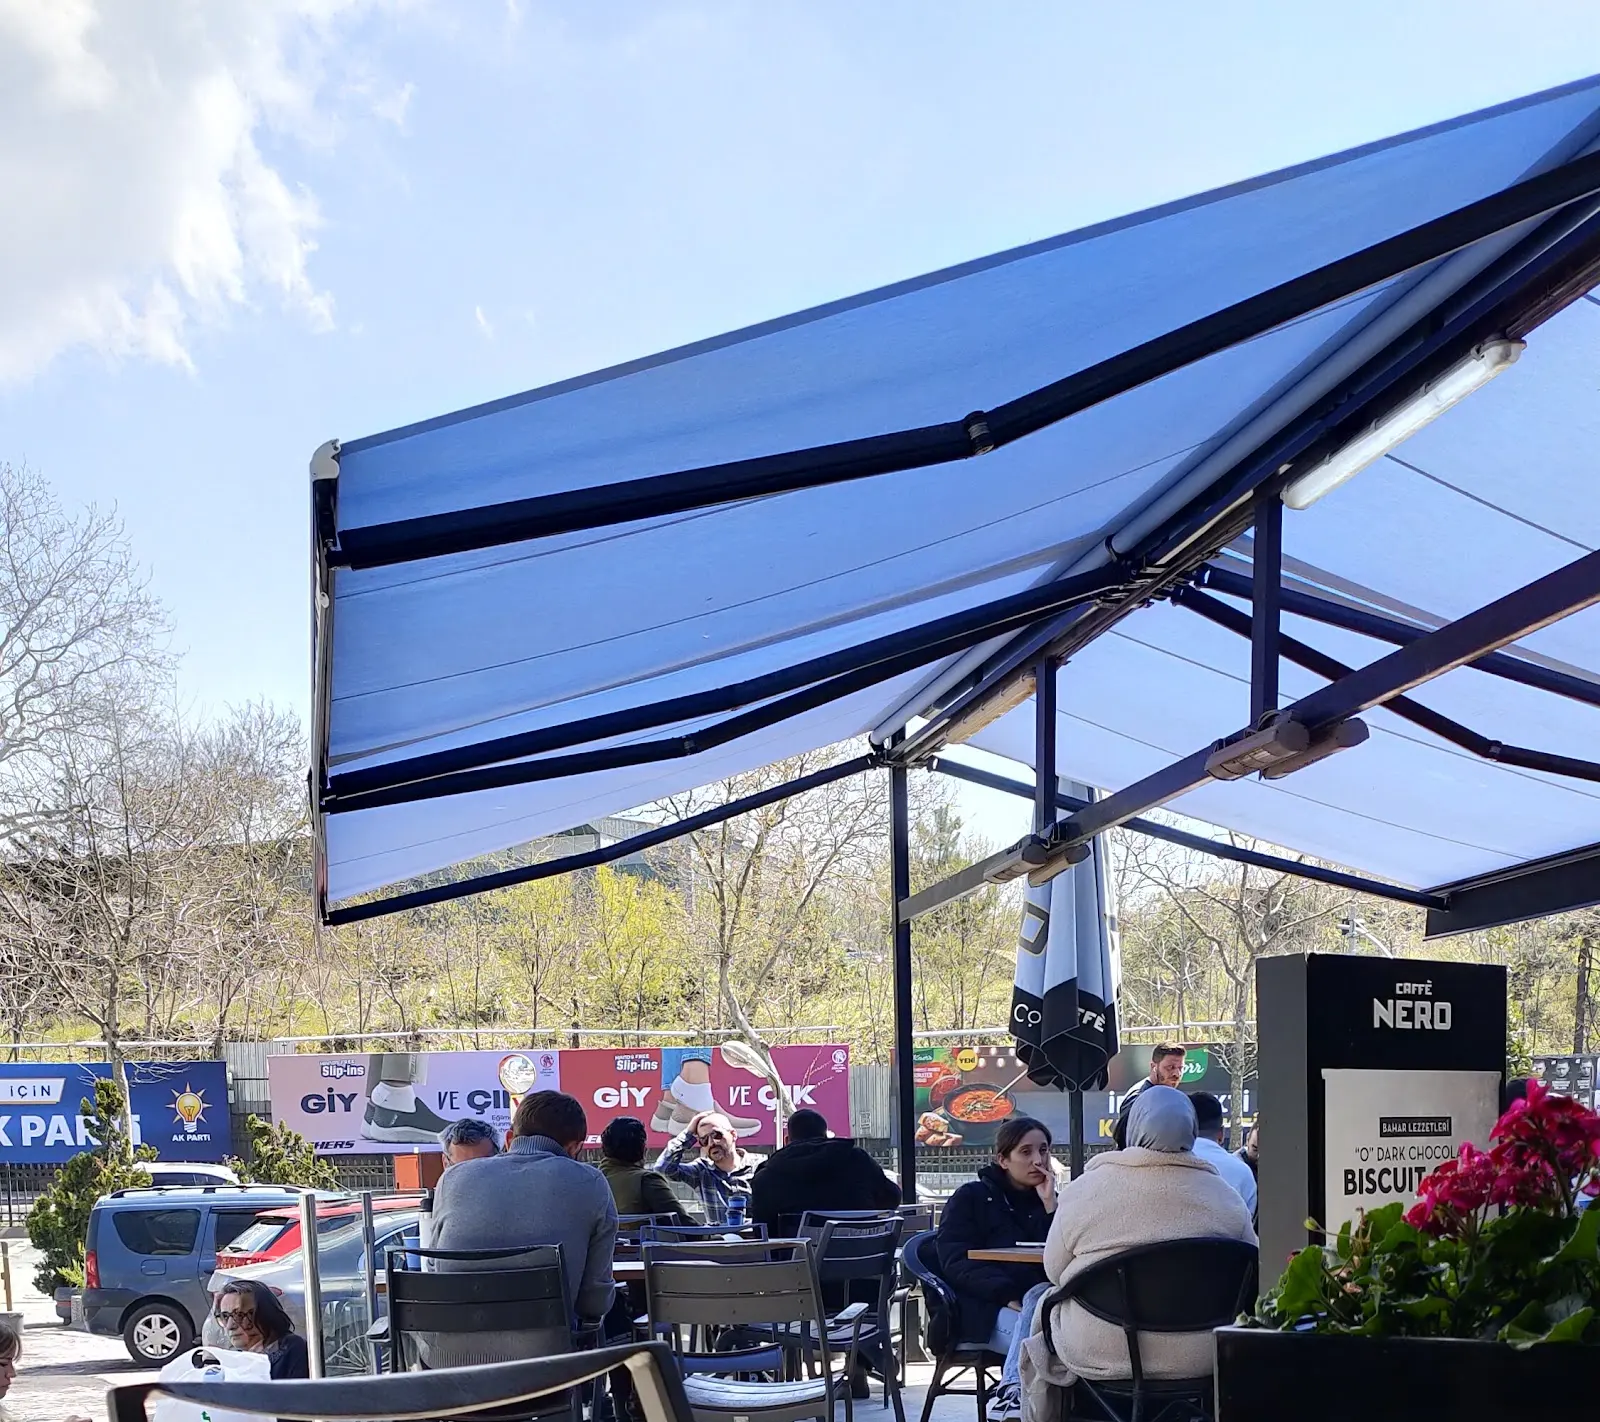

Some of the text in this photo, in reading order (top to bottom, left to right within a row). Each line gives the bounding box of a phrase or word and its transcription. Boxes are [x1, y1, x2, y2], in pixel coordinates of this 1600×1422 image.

[1396, 980, 1432, 996] CAFFÈ
[1373, 998, 1451, 1030] NERO
[321, 1065, 365, 1079] Slip-ins
[616, 1060, 659, 1073] Slip-ins
[1182, 1063, 1205, 1074] orr
[10, 1085, 52, 1098] İÇİN
[593, 1081, 652, 1108] GİY
[729, 1086, 752, 1106] VE
[301, 1087, 358, 1114] GİY
[438, 1091, 460, 1110] VE
[1382, 1120, 1450, 1133] BAHAR LEZZETLERİ
[172, 1134, 185, 1142] AK
[1377, 1146, 1405, 1161] DARK
[1343, 1166, 1427, 1196] BISCUIT
